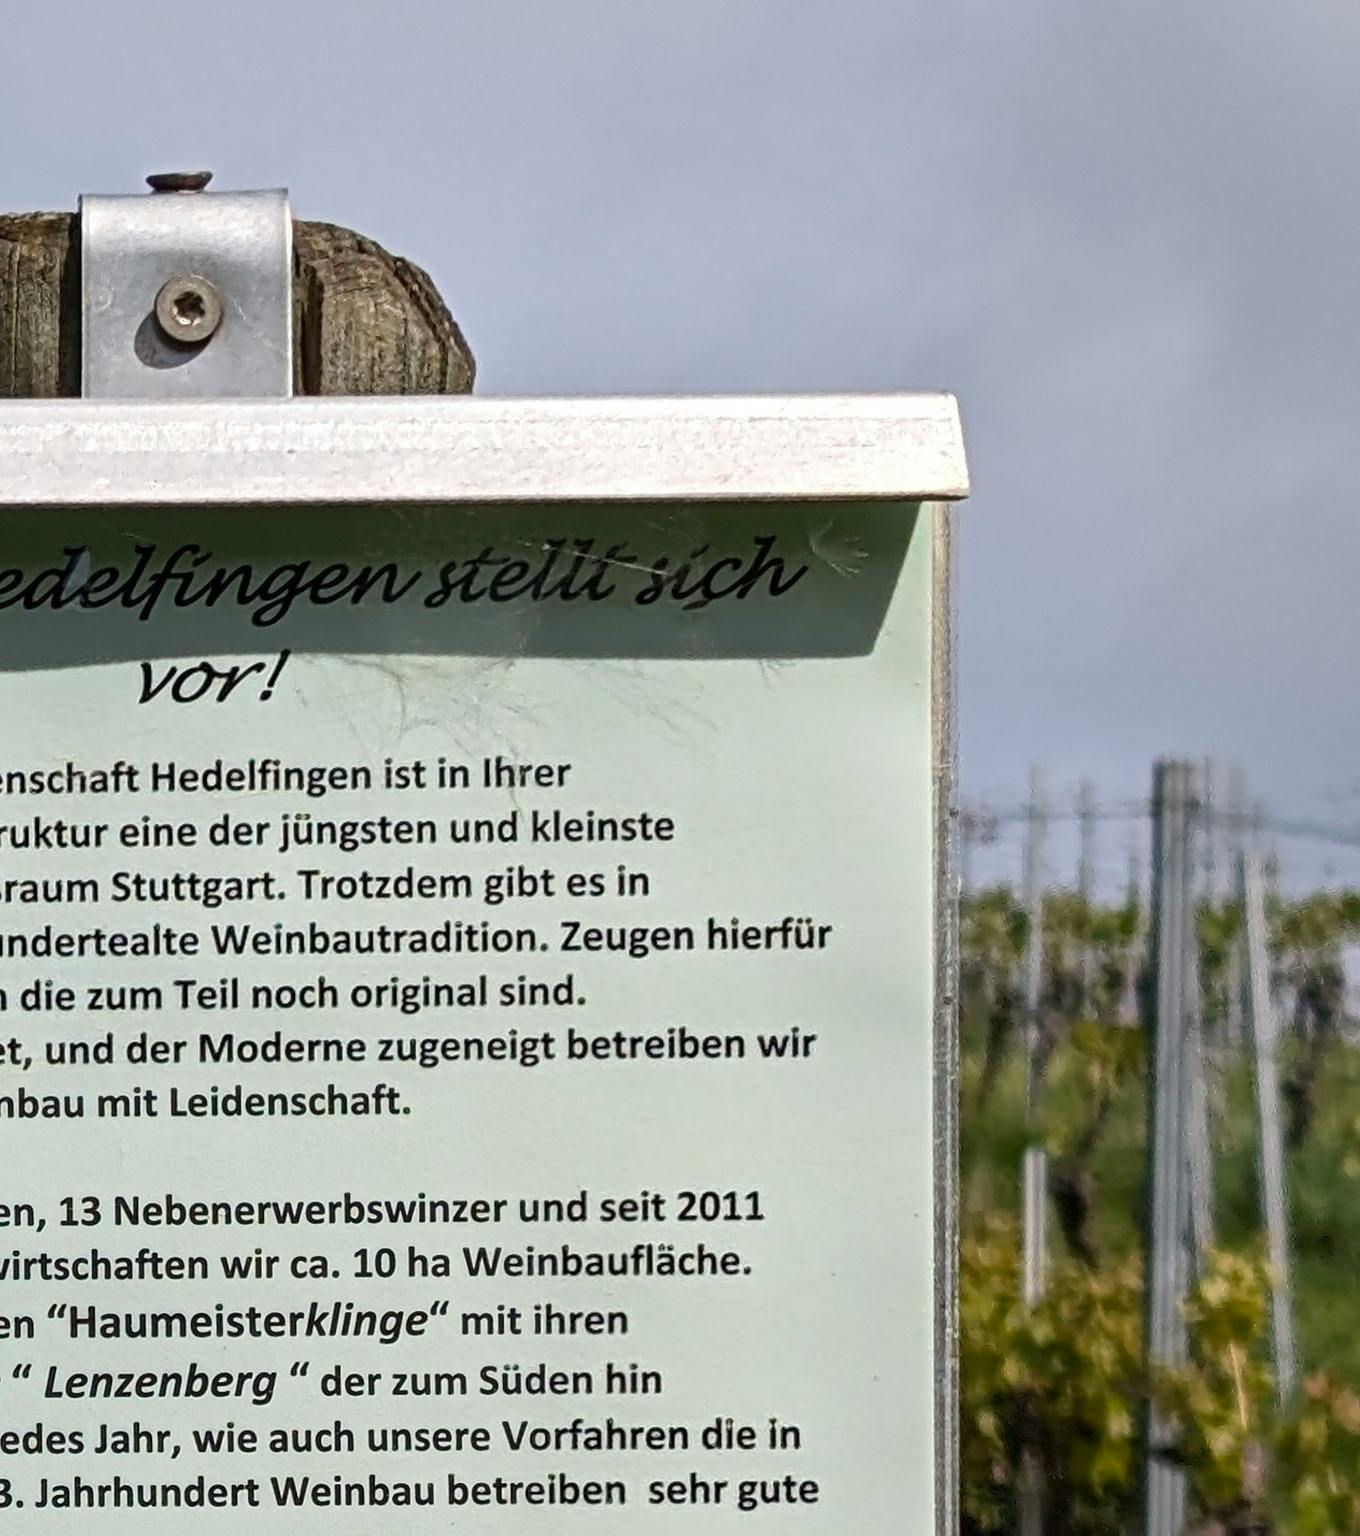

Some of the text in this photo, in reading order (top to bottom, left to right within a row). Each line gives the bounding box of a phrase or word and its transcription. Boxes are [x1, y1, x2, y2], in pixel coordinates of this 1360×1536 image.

[423, 538, 638, 609] stellt
[633, 535, 812, 610] sich
[138, 648, 293, 705] vor!
[151, 758, 372, 799] Hedelfingen
[383, 757, 427, 790] ist
[437, 756, 471, 789] in
[483, 755, 572, 789] Ihrer
[118, 814, 198, 848] eine
[208, 812, 272, 847] der
[278, 812, 437, 852] jüngsten
[449, 809, 519, 844] und
[531, 809, 676, 843] kleinste
[110, 871, 286, 909] Stuttgart.
[296, 865, 473, 901] Trotzdem
[483, 864, 556, 906] gibt
[566, 873, 606, 898] es
[616, 863, 650, 897] in
[210, 919, 549, 956] Weinbautradition.
[560, 920, 695, 960] Zeugen
[707, 916, 833, 951] hierfür
[19, 978, 76, 1012] die
[86, 986, 163, 1012] zum
[172, 976, 239, 1011] Teil
[251, 975, 339, 1010] noch
[350, 974, 488, 1015] original
[499, 973, 587, 1008] sind.
[45, 1031, 114, 1066] und
[126, 1031, 188, 1065] der
[198, 1030, 367, 1064] Moderne
[377, 1028, 557, 1067] zugeneigt
[567, 1025, 746, 1061] betreiben
[756, 1026, 818, 1059] wir
[97, 1086, 159, 1118] mit
[169, 1082, 412, 1118] Leidenschaft.
[59, 1195, 102, 1227] 13
[114, 1191, 509, 1227] Nebenerwerbswinzer
[519, 1189, 588, 1223] und
[599, 1189, 667, 1223] seit
[676, 1190, 766, 1223] 2011
[219, 1247, 281, 1280] wir
[289, 1255, 341, 1280] ca.
[353, 1247, 397, 1279] 10
[407, 1245, 451, 1278] ha
[462, 1242, 752, 1278] Weinbaufläche.
[461, 1304, 523, 1336] mit
[533, 1302, 629, 1336] ihren
[43, 1361, 278, 1404] Lenzenberg
[320, 1364, 383, 1397] der
[391, 1372, 468, 1397] zum
[479, 1362, 594, 1396] Süden
[605, 1361, 663, 1395] hin
[93, 1420, 182, 1460] Jahr,
[191, 1421, 258, 1454] wie
[268, 1419, 355, 1454] auch
[367, 1427, 491, 1453] unsere
[501, 1416, 689, 1452] Vorfahren
[701, 1416, 757, 1451] die
[768, 1417, 802, 1451] in
[34, 1474, 260, 1509] Jahrhundert
[269, 1473, 435, 1508] Weinbau
[447, 1472, 627, 1506] betreiben
[648, 1471, 729, 1505] sehr
[736, 1474, 820, 1508] gute
